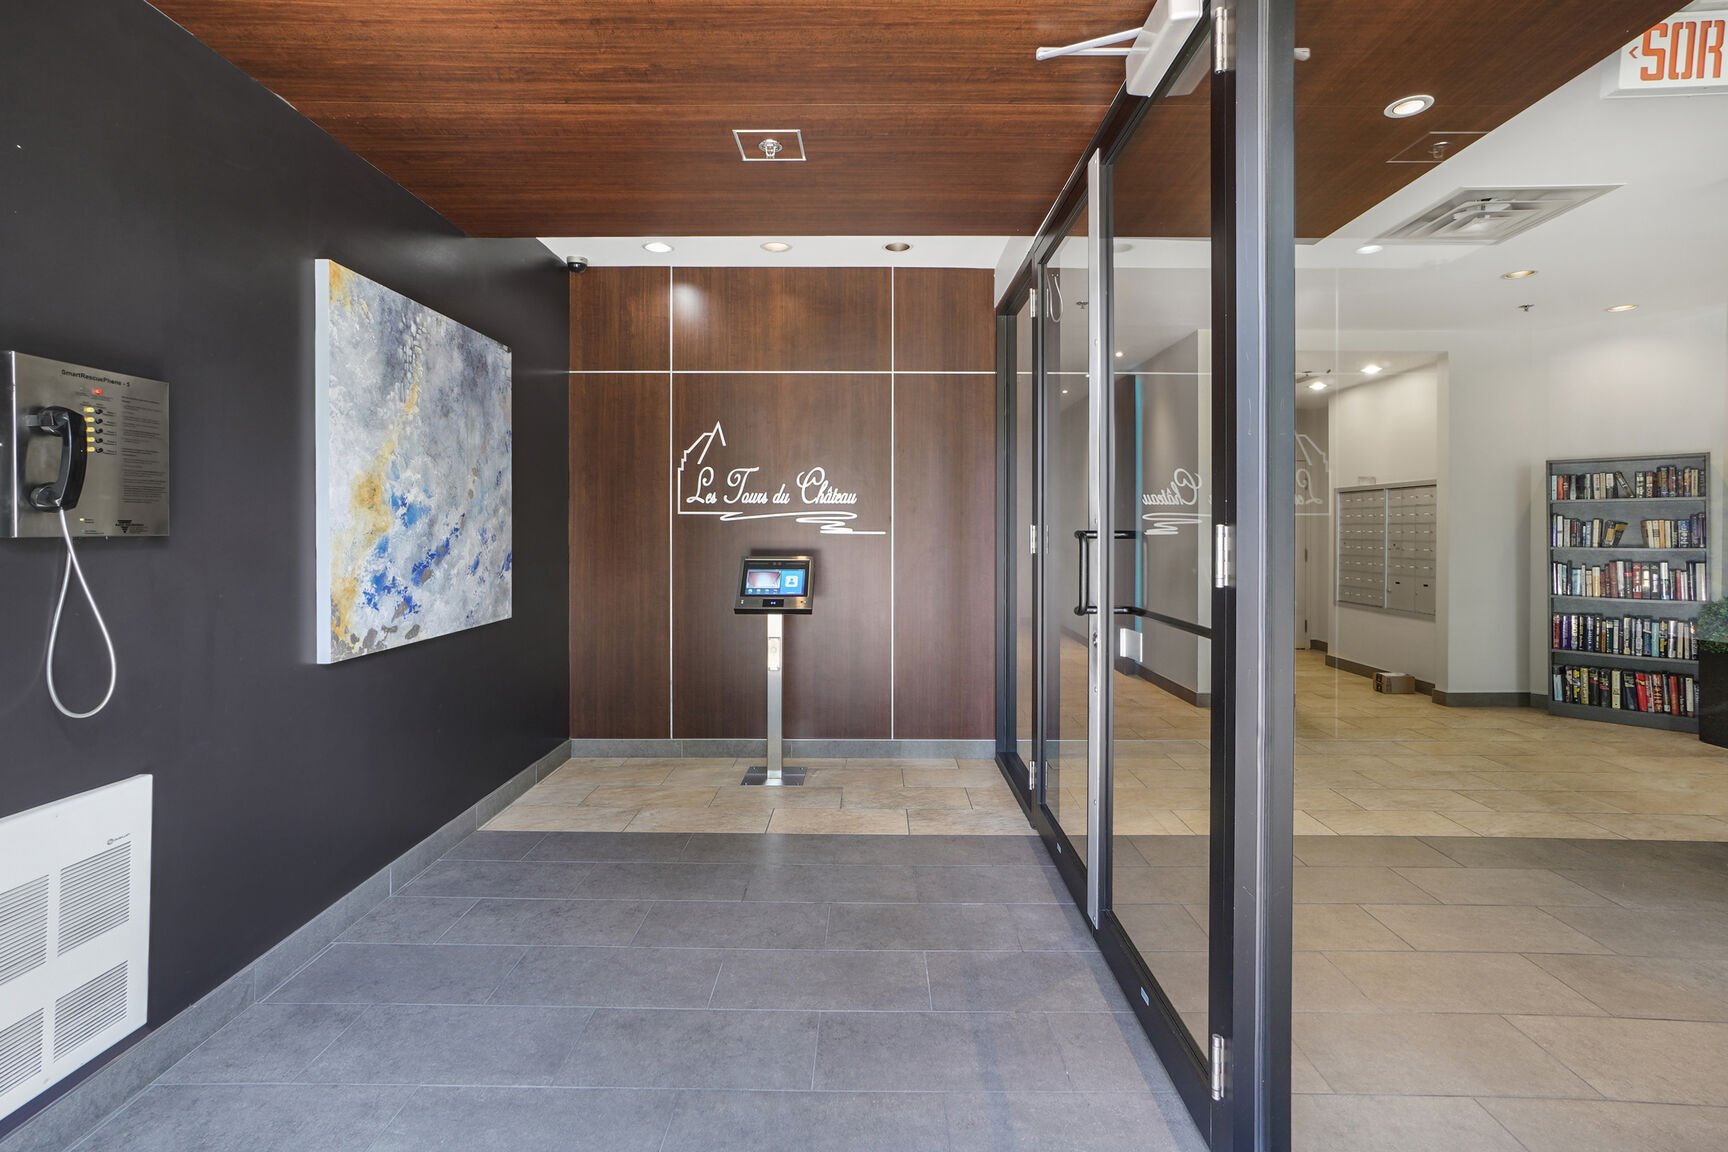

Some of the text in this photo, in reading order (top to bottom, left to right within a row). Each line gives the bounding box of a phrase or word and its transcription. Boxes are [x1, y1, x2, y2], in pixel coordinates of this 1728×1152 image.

[686, 466, 857, 504] Les Tours du Château
